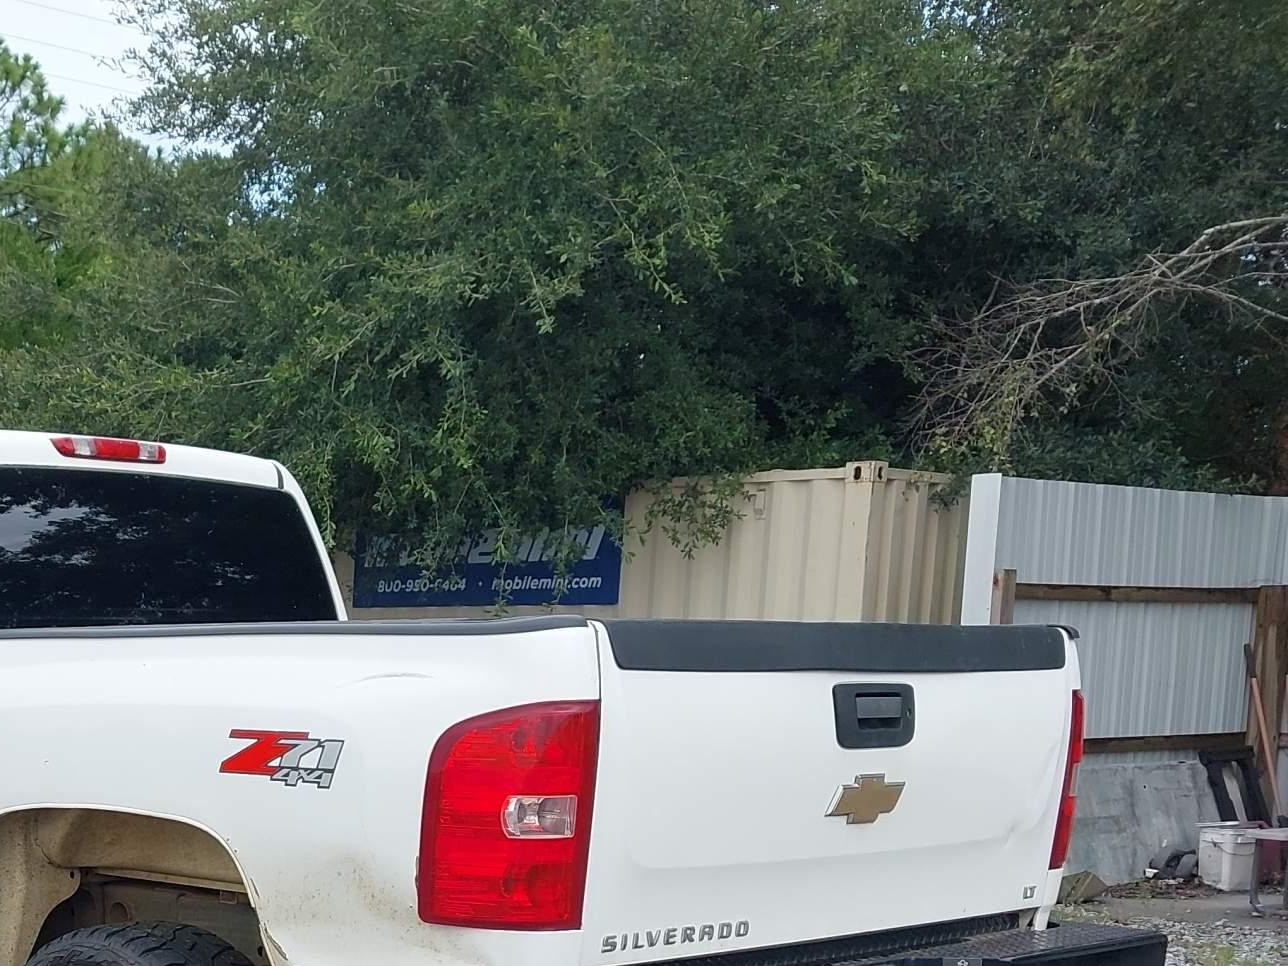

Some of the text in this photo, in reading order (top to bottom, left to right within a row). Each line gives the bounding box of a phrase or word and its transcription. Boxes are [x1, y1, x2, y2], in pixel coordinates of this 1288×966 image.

[219, 729, 344, 776] Z71
[1023, 885, 1037, 900] LT
[601, 920, 750, 954] SILVERADO
